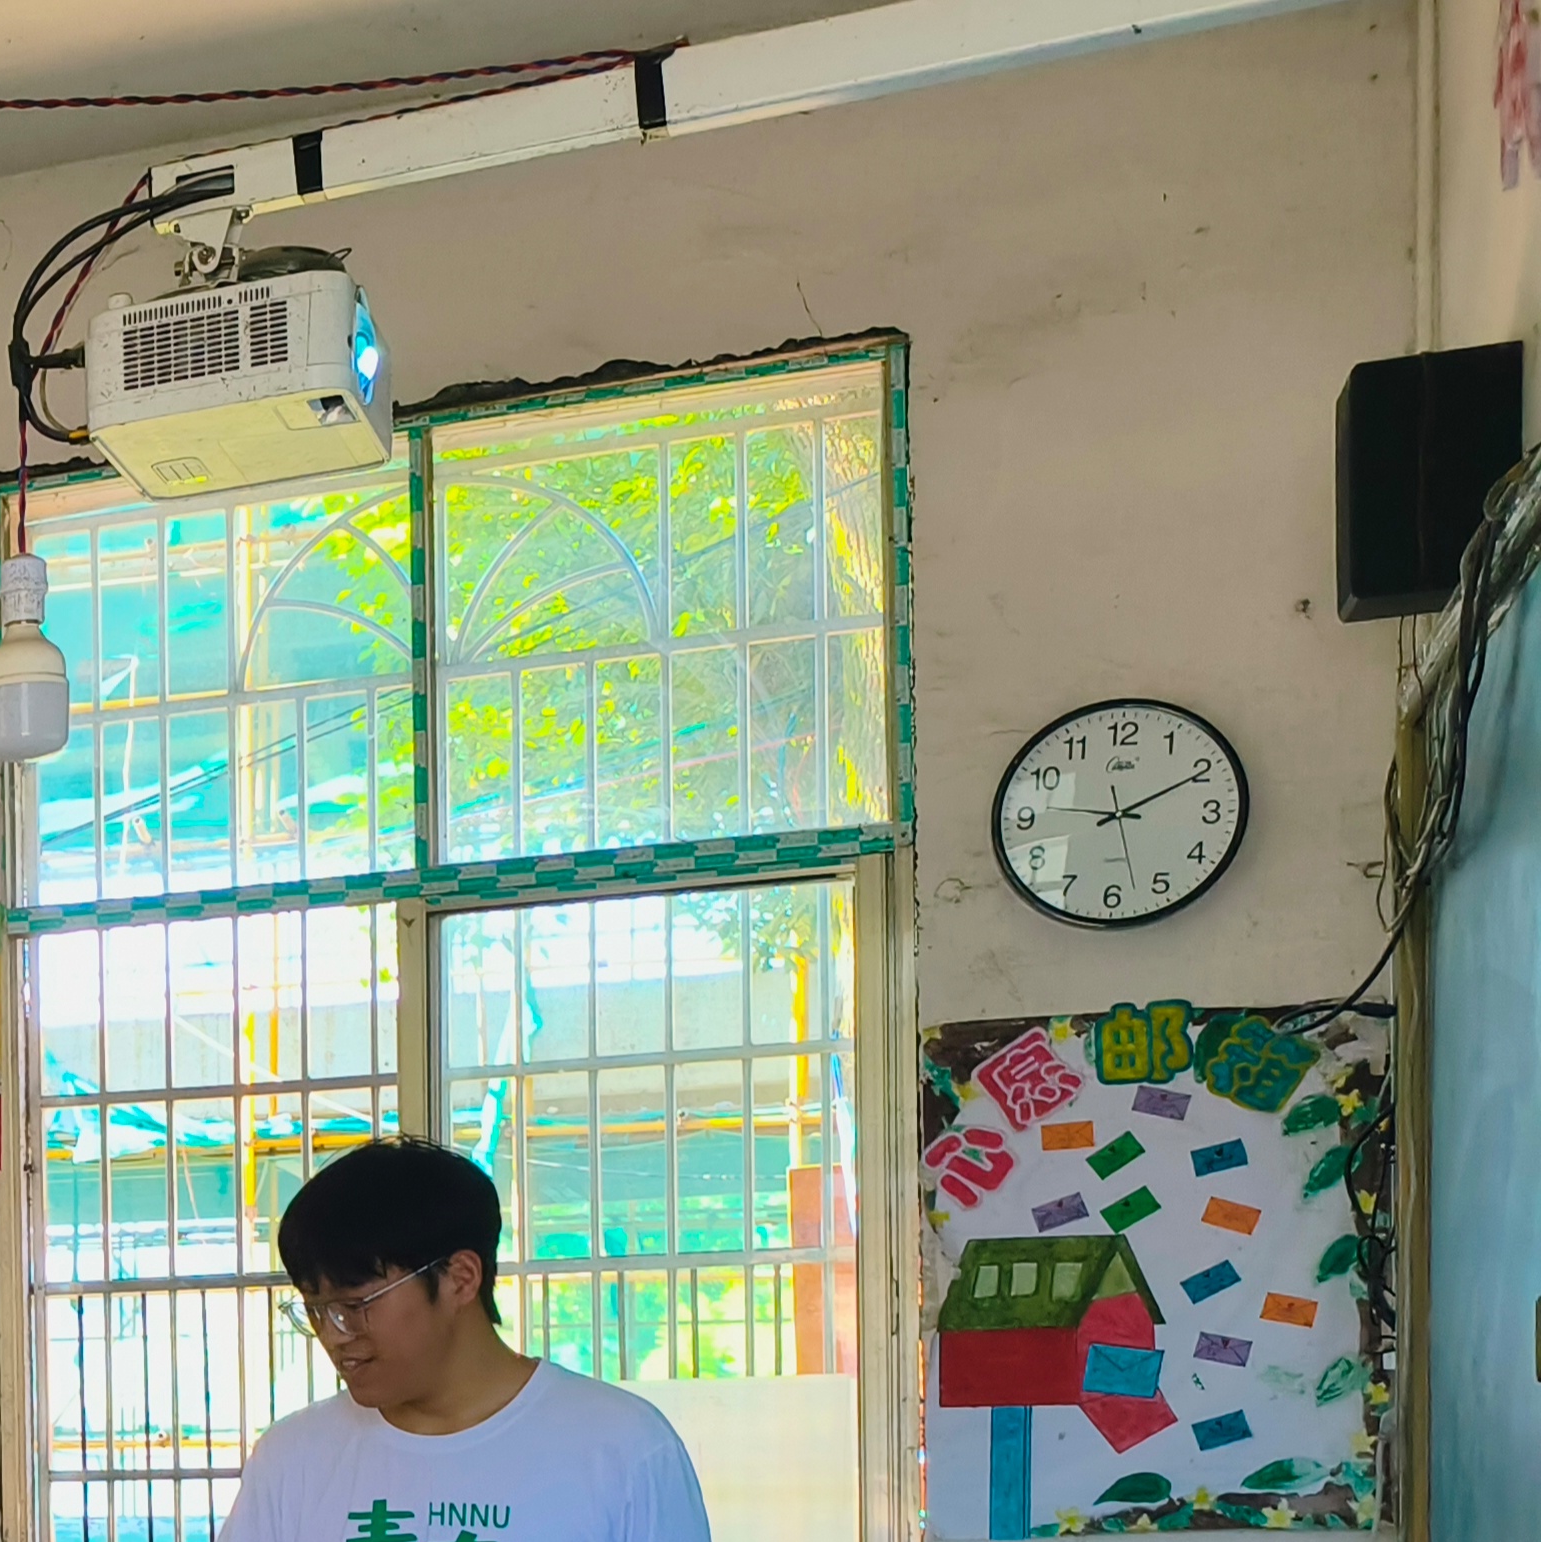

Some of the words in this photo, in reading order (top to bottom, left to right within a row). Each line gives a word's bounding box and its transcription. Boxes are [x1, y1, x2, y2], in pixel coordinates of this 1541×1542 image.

[1107, 721, 1139, 746] 12
[1163, 731, 1176, 755] 1
[1063, 735, 1087, 760] 11
[1030, 766, 1061, 791] 10
[1191, 758, 1213, 783] 2
[1016, 806, 1035, 830] 9
[1201, 799, 1222, 824] 3
[1029, 845, 1046, 870] 8
[1186, 841, 1207, 865] 4
[1061, 874, 1078, 897] 7
[1151, 872, 1171, 894] 5
[1102, 884, 1122, 908] 6
[428, 1501, 511, 1529] HNNU
